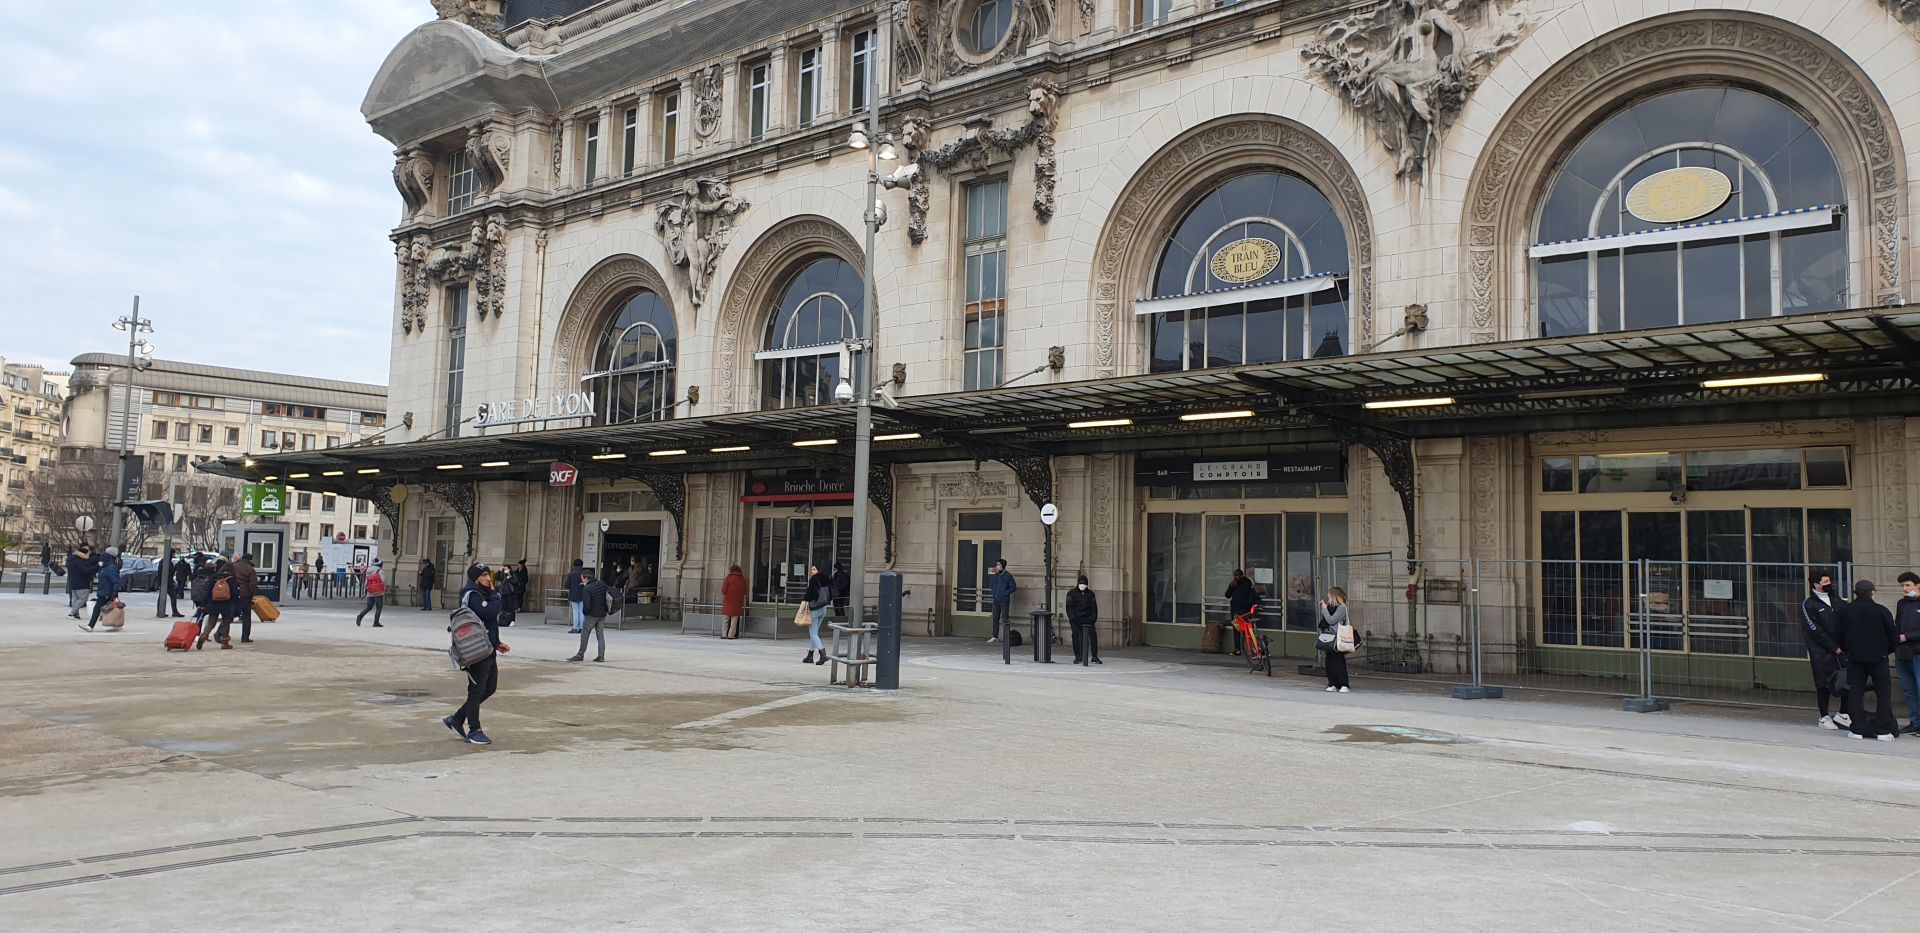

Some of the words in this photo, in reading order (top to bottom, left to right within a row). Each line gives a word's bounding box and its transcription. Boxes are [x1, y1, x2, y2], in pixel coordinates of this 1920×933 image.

[1231, 249, 1259, 263] TRAIN
[1234, 262, 1258, 273] BLEU
[475, 400, 516, 424] GARE
[523, 398, 543, 419] DE
[550, 391, 595, 417] LYON
[1283, 465, 1322, 473] RESTAURANT
[550, 470, 573, 483] SNCF
[784, 480, 816, 493] Brioche
[819, 479, 846, 492] Dorée
